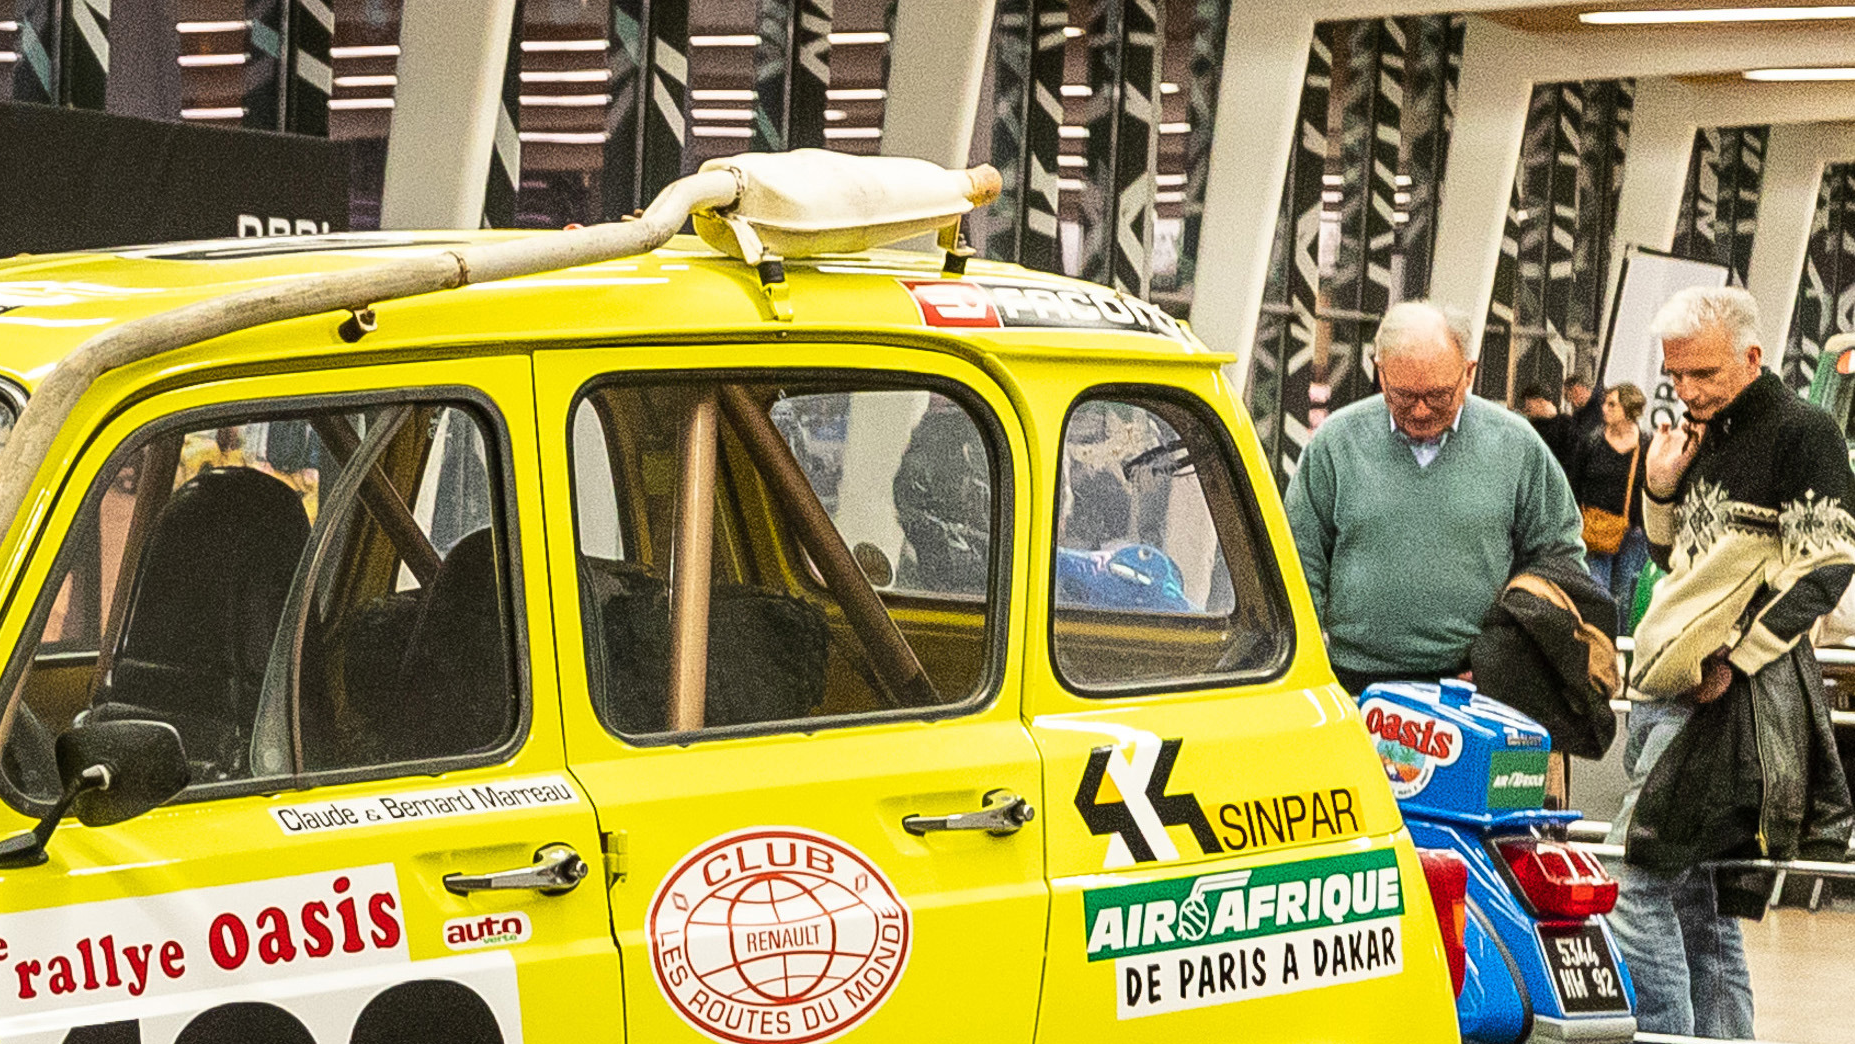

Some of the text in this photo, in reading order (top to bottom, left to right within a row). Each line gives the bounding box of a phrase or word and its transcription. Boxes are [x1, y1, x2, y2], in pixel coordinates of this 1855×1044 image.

[277, 782, 573, 832] Claude & Bernard Marreau
[1219, 787, 1359, 852] SINPAR
[702, 842, 835, 887] CLUB
[13, 935, 187, 999] rallye
[207, 875, 402, 972] oasis
[447, 916, 522, 944] auto
[746, 923, 822, 953] RENAULT
[1087, 866, 1399, 953] AIR AFRIQUE
[659, 904, 902, 1036] LES ROUTES DU MONDE
[1125, 926, 1397, 1007] DE PARIS A DAKAR
[1591, 967, 1618, 998] 92
